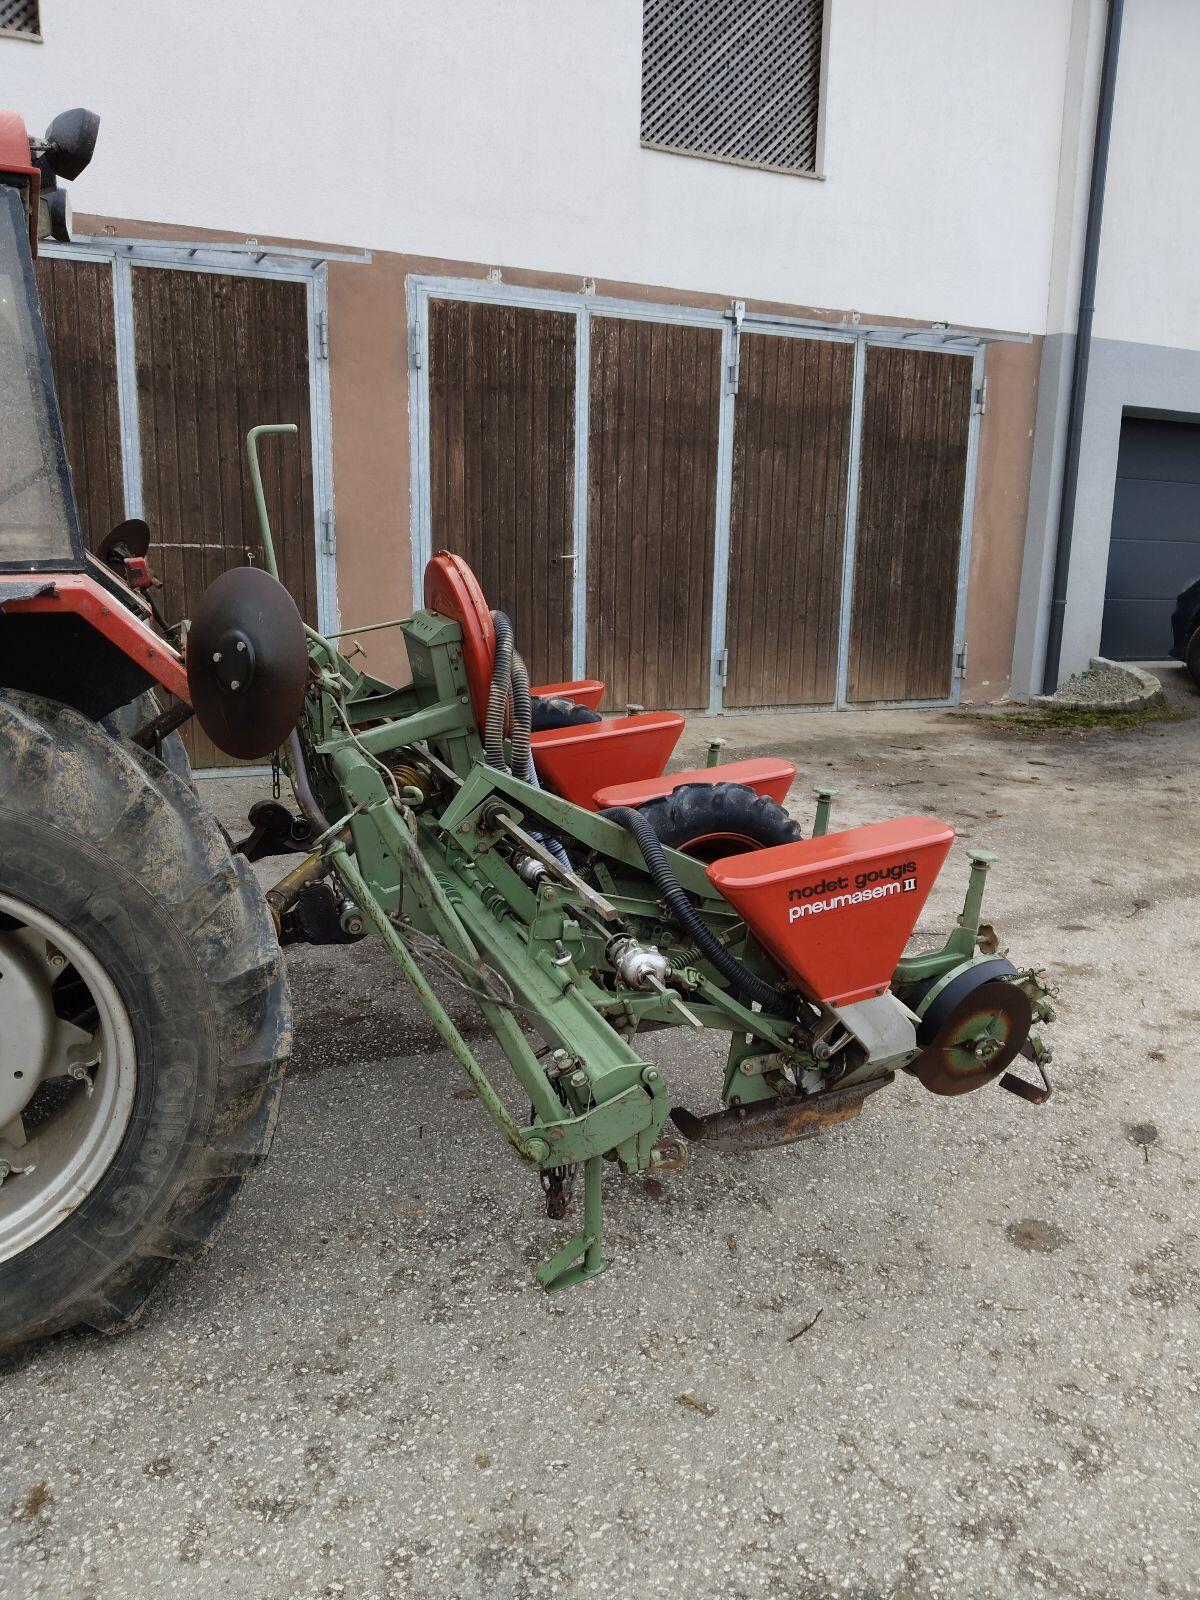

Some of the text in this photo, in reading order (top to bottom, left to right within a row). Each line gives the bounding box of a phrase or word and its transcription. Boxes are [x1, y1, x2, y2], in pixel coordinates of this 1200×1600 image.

[788, 860, 917, 901] nodet gougis
[789, 878, 916, 923] pneumasem II
